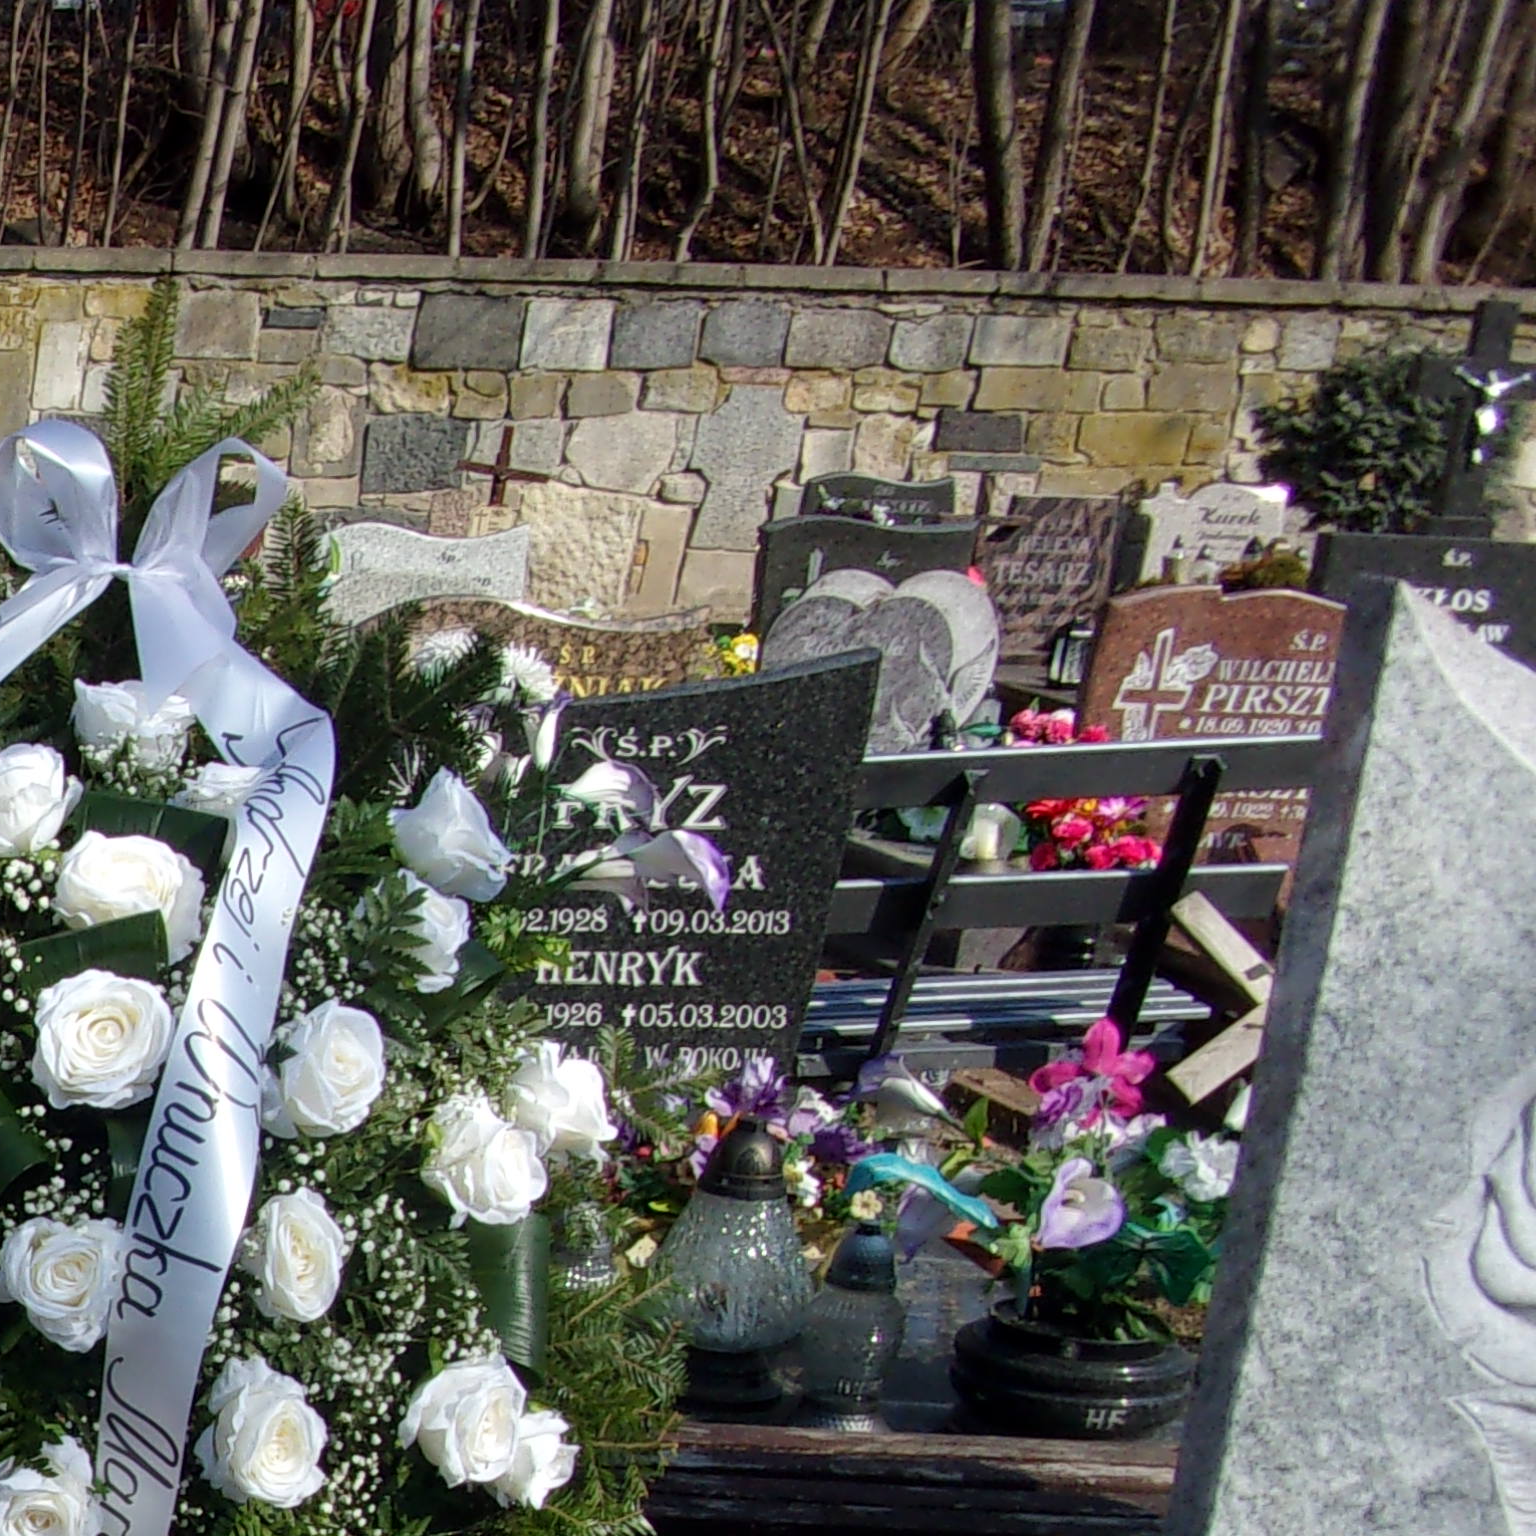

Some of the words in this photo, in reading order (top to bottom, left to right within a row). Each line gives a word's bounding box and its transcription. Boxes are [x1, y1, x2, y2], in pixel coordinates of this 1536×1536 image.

[992, 559, 1091, 586] TESARZ
[615, 726, 677, 758] Ś.P.
[518, 907, 609, 934] 2.1928
[649, 909, 791, 936] 09.03.2013
[534, 944, 704, 986] HENRYK
[638, 1003, 788, 1030] 05.03.2003
[117, 998, 264, 1320] Wnuczka
